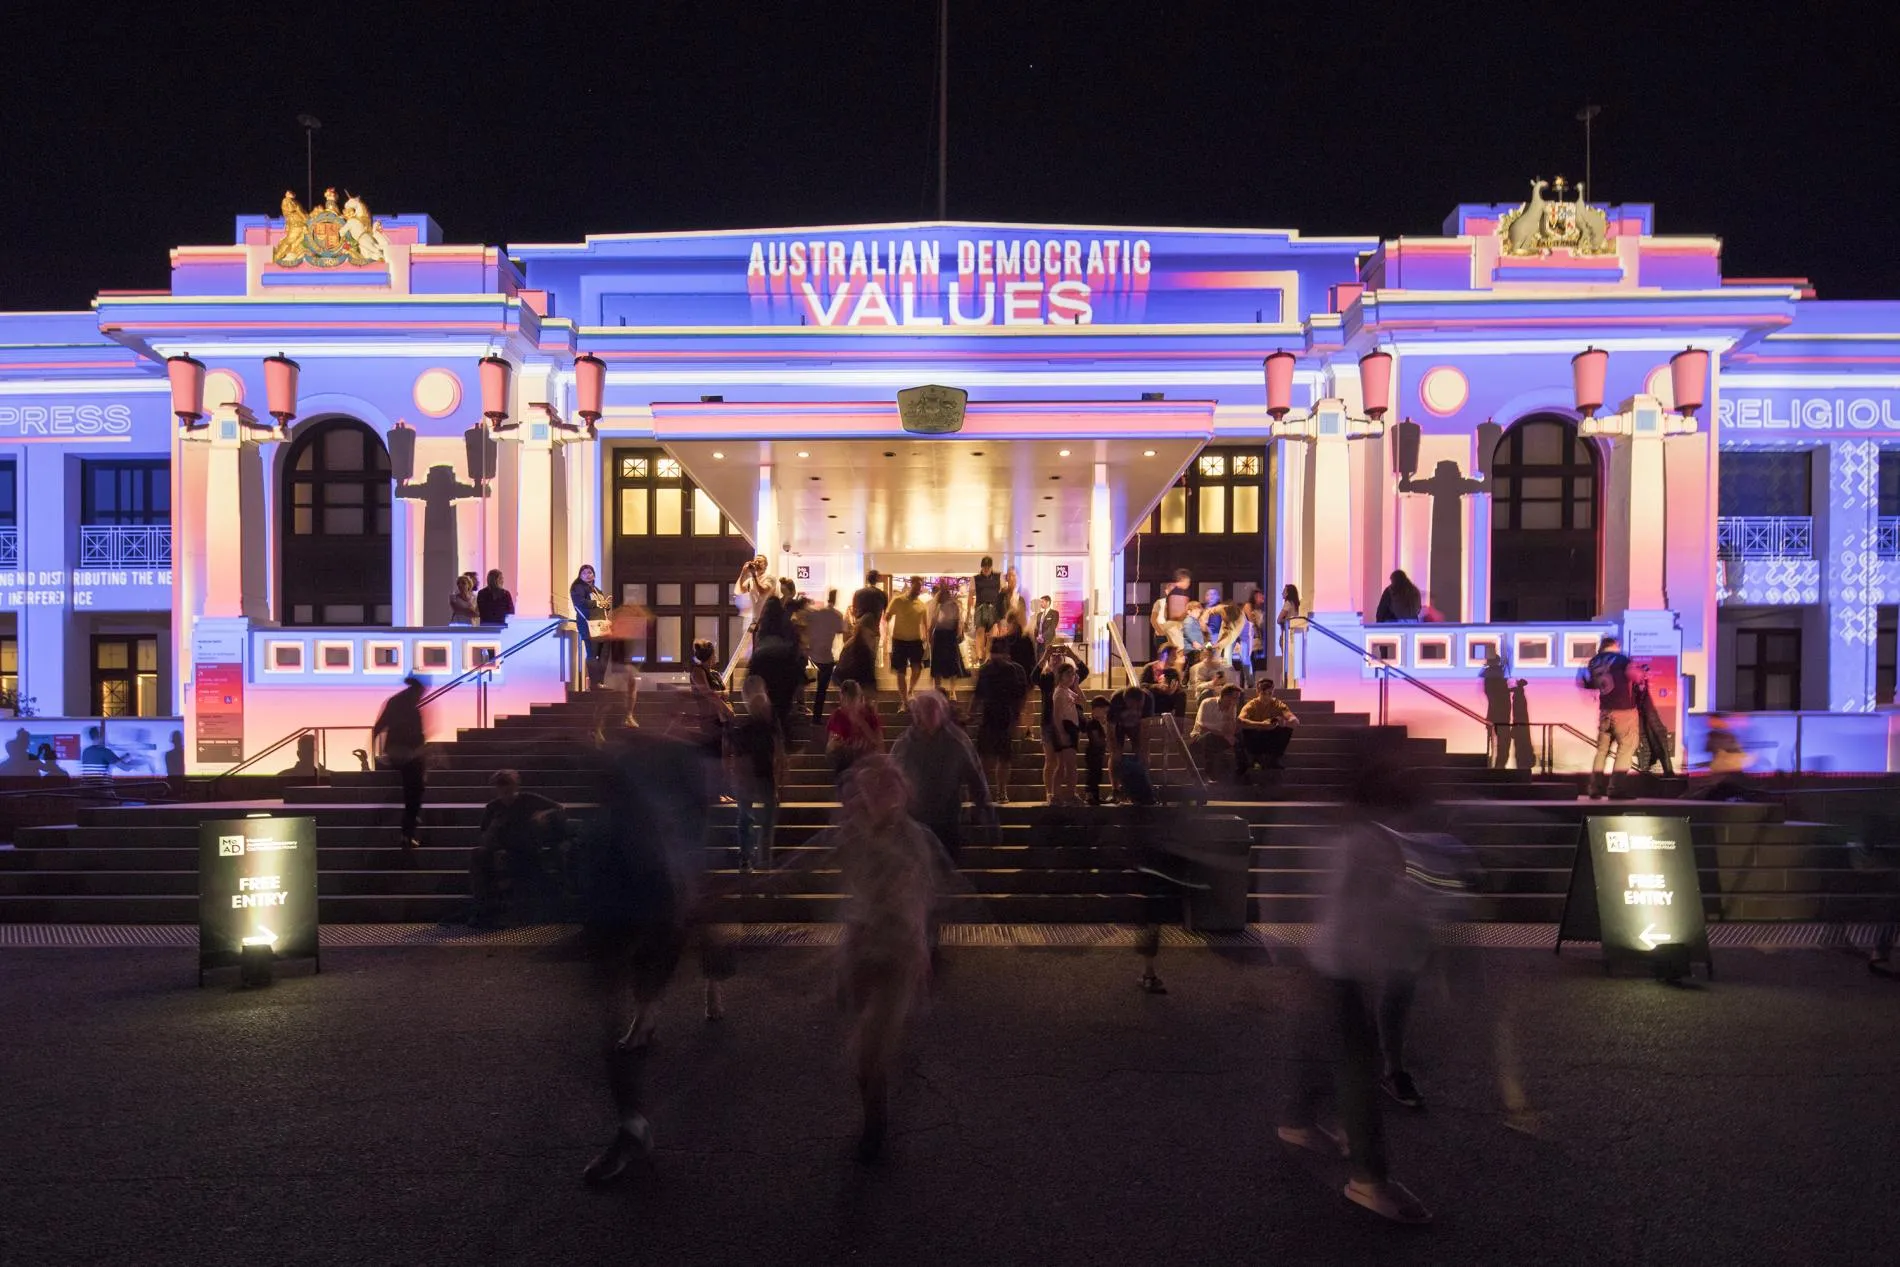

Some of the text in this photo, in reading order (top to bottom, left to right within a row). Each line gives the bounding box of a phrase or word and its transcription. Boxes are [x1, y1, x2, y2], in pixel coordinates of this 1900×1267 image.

[748, 239, 1151, 275] AUSTRALIAN DEMOCRATIC
[802, 281, 1093, 325] VALUES
[0, 404, 131, 434] PRESS
[132, 571, 153, 586] THE
[223, 845, 241, 854] AD
[239, 876, 281, 891] FREE
[231, 892, 288, 909] ENTRY
[1624, 890, 1674, 906] ENTRY
